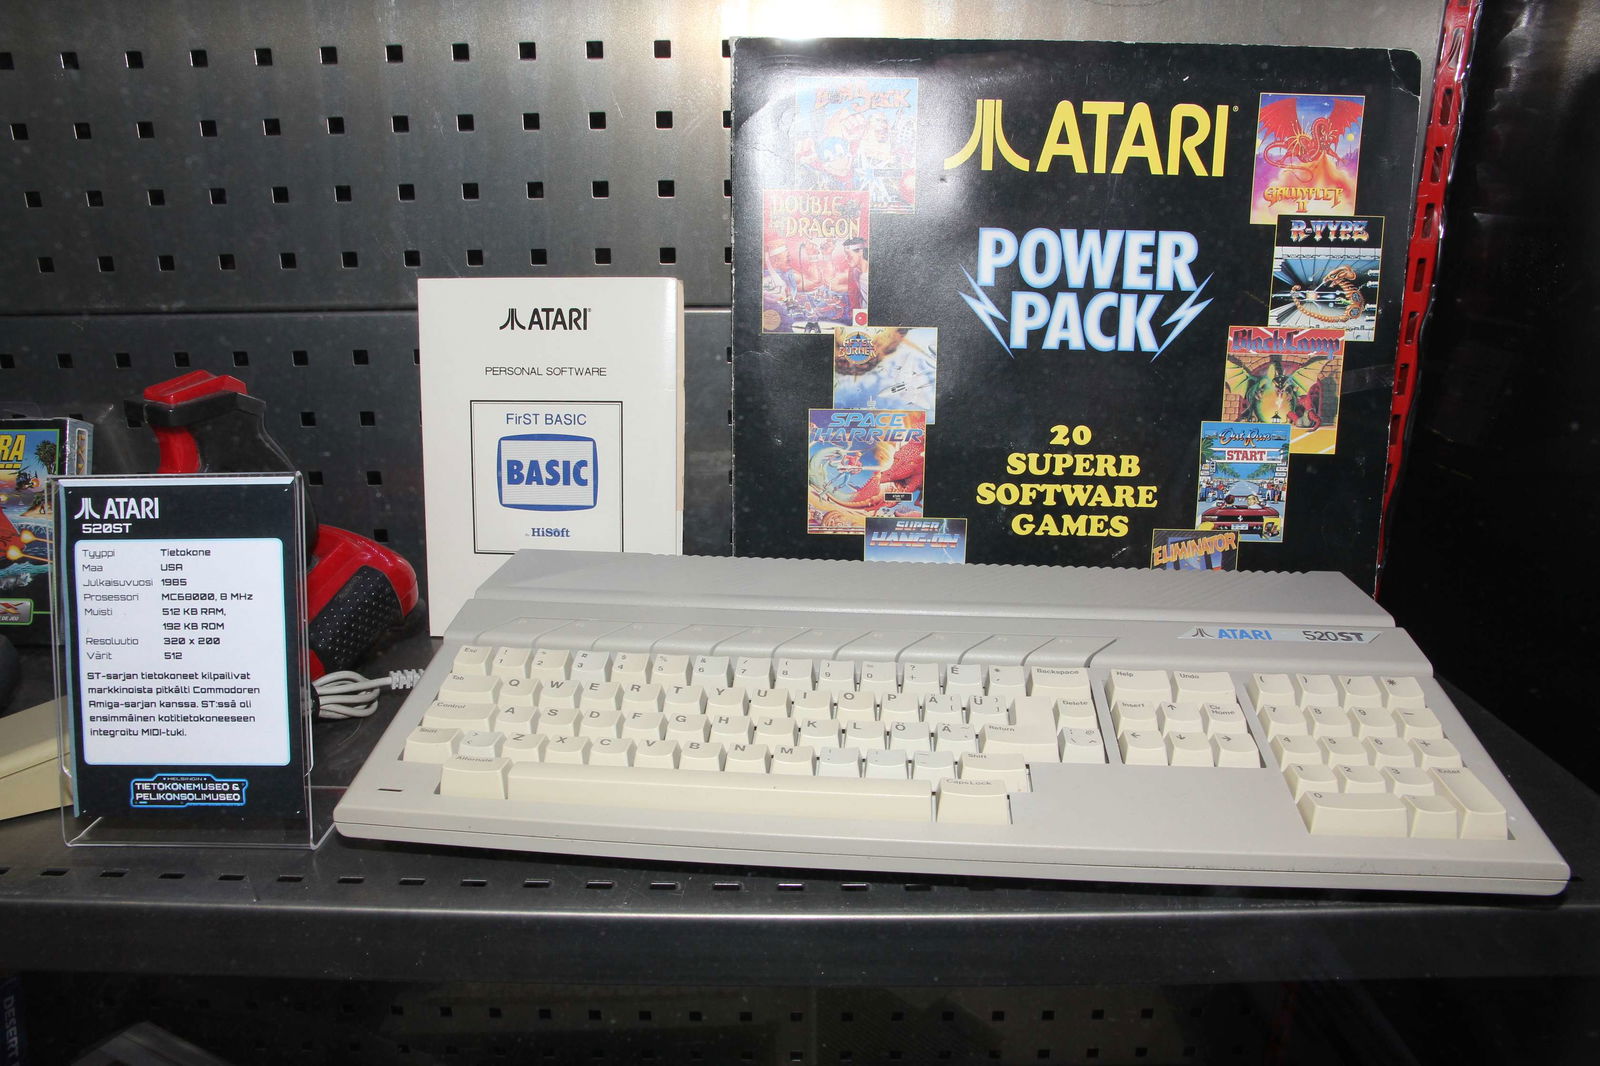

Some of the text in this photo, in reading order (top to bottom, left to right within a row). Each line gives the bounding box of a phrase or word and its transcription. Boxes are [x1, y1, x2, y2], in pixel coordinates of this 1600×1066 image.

[1036, 100, 1228, 177] ATARI
[784, 216, 860, 238] DRAGON
[977, 226, 1199, 291] POWER
[527, 307, 588, 330] ATARI
[1008, 290, 1164, 353] PACK
[843, 338, 874, 348] AFTER
[839, 346, 876, 358] BURNER
[485, 366, 607, 376] PERSONAL SOFTWARE
[545, 413, 587, 426] BASIC
[829, 413, 905, 427] SPACE
[813, 427, 924, 443] HARRIER
[1049, 424, 1092, 447] 20
[1226, 450, 1267, 462] START
[1006, 452, 1140, 478] SUPERB
[506, 459, 588, 486] BASIC
[975, 482, 1158, 508] SOFTWARE
[103, 497, 159, 519] ATARI
[82, 523, 132, 534] 520ST
[896, 520, 940, 532] SUPER
[1010, 513, 1129, 538] GAMES
[531, 527, 570, 537] HiSoft
[81, 548, 211, 559] Tyyppi Tietokone
[1152, 532, 1237, 566] ELIMINATOR
[82, 563, 183, 572] Maa USA
[83, 578, 187, 587] Julkaisuvuosi 1985
[83, 593, 139, 601] Prosessori
[161, 593, 217, 601] MC68000,
[220, 593, 228, 601] 8
[84, 608, 226, 616] Muisti 512 KB RAM,
[162, 622, 224, 630] 192 KB ROM
[1218, 629, 1364, 642] ATARI 520ST
[85, 637, 139, 645] Resoluutio
[163, 637, 186, 645] 320
[198, 637, 220, 645] 200
[86, 651, 182, 660] Värit 512
[951, 665, 959, 675] É
[87, 672, 251, 682] ST-sarjan tietokoneet kilpailivat
[508, 679, 520, 687] Q
[550, 680, 564, 689] W
[589, 683, 600, 691] E
[630, 684, 641, 692] R
[88, 685, 260, 695] markkinoista pitkälti Commodoren
[674, 686, 683, 694] T
[716, 688, 725, 696] Y
[757, 689, 768, 697] U
[843, 692, 855, 700] O
[974, 695, 983, 705] Ü
[88, 699, 251, 710] Amiga-sarjan kanssa. ST:ssä oli
[89, 713, 255, 722] ensimmäinen kotitietokoneeseen
[675, 715, 687, 723] G
[718, 716, 729, 724] H
[807, 720, 817, 728] K
[853, 722, 861, 730] L
[895, 722, 906, 731] Ö
[90, 728, 186, 738] integroitu MIDI-tuki.
[512, 733, 525, 741] Z
[556, 736, 568, 744] X
[734, 744, 746, 752] N
[134, 783, 241, 791] TIETOKONEMUSEO &
[135, 793, 241, 801] PELIKONSOLIMUSEO
